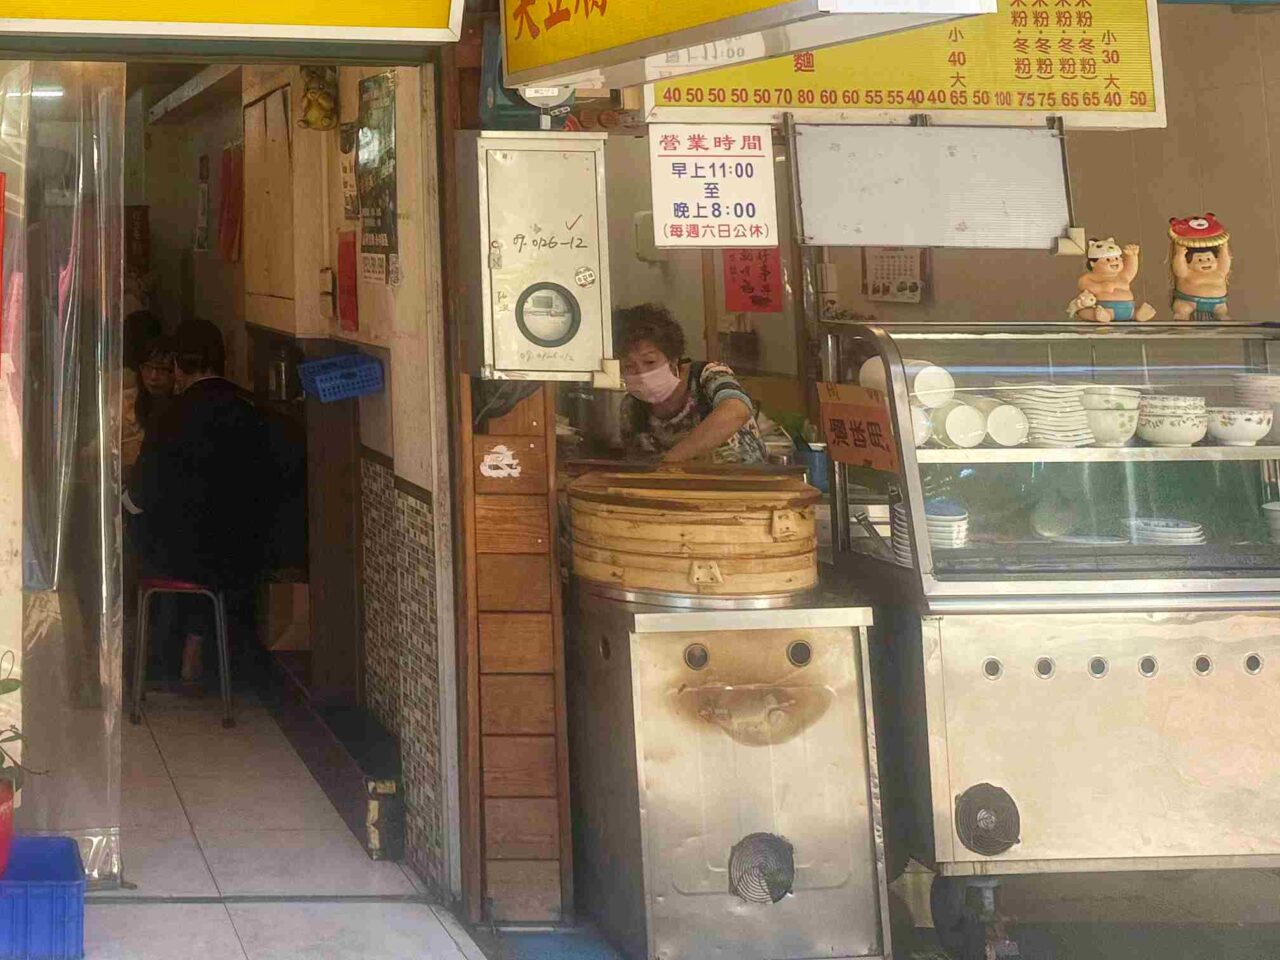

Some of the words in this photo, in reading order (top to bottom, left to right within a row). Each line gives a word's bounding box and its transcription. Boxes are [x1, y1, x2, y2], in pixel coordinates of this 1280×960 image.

[948, 51, 966, 66] 40
[1102, 50, 1120, 65] 30
[663, 88, 681, 104] 40
[686, 88, 703, 104] 50
[708, 88, 725, 104] 50
[731, 88, 748, 104] 50
[753, 88, 771, 104] 50
[775, 88, 793, 104] 70
[798, 89, 815, 104] 80
[820, 89, 838, 104] 60
[842, 89, 859, 104] 60
[865, 89, 883, 104] 55
[887, 90, 904, 105] 55
[906, 90, 924, 105] 40
[927, 90, 946, 105] 40
[972, 91, 990, 106] 50
[950, 90, 967, 105] 65
[994, 92, 1012, 106] 100
[1017, 92, 1035, 107] 75
[1038, 92, 1056, 107] 75
[1061, 91, 1079, 106] 65
[1082, 91, 1100, 106] 65
[1104, 91, 1122, 106] 40
[1129, 91, 1147, 106] 50
[659, 134, 763, 152] 營業時間
[671, 162, 754, 179] 早上11:00
[704, 182, 720, 199] 至
[673, 202, 757, 219] 晚上8:00
